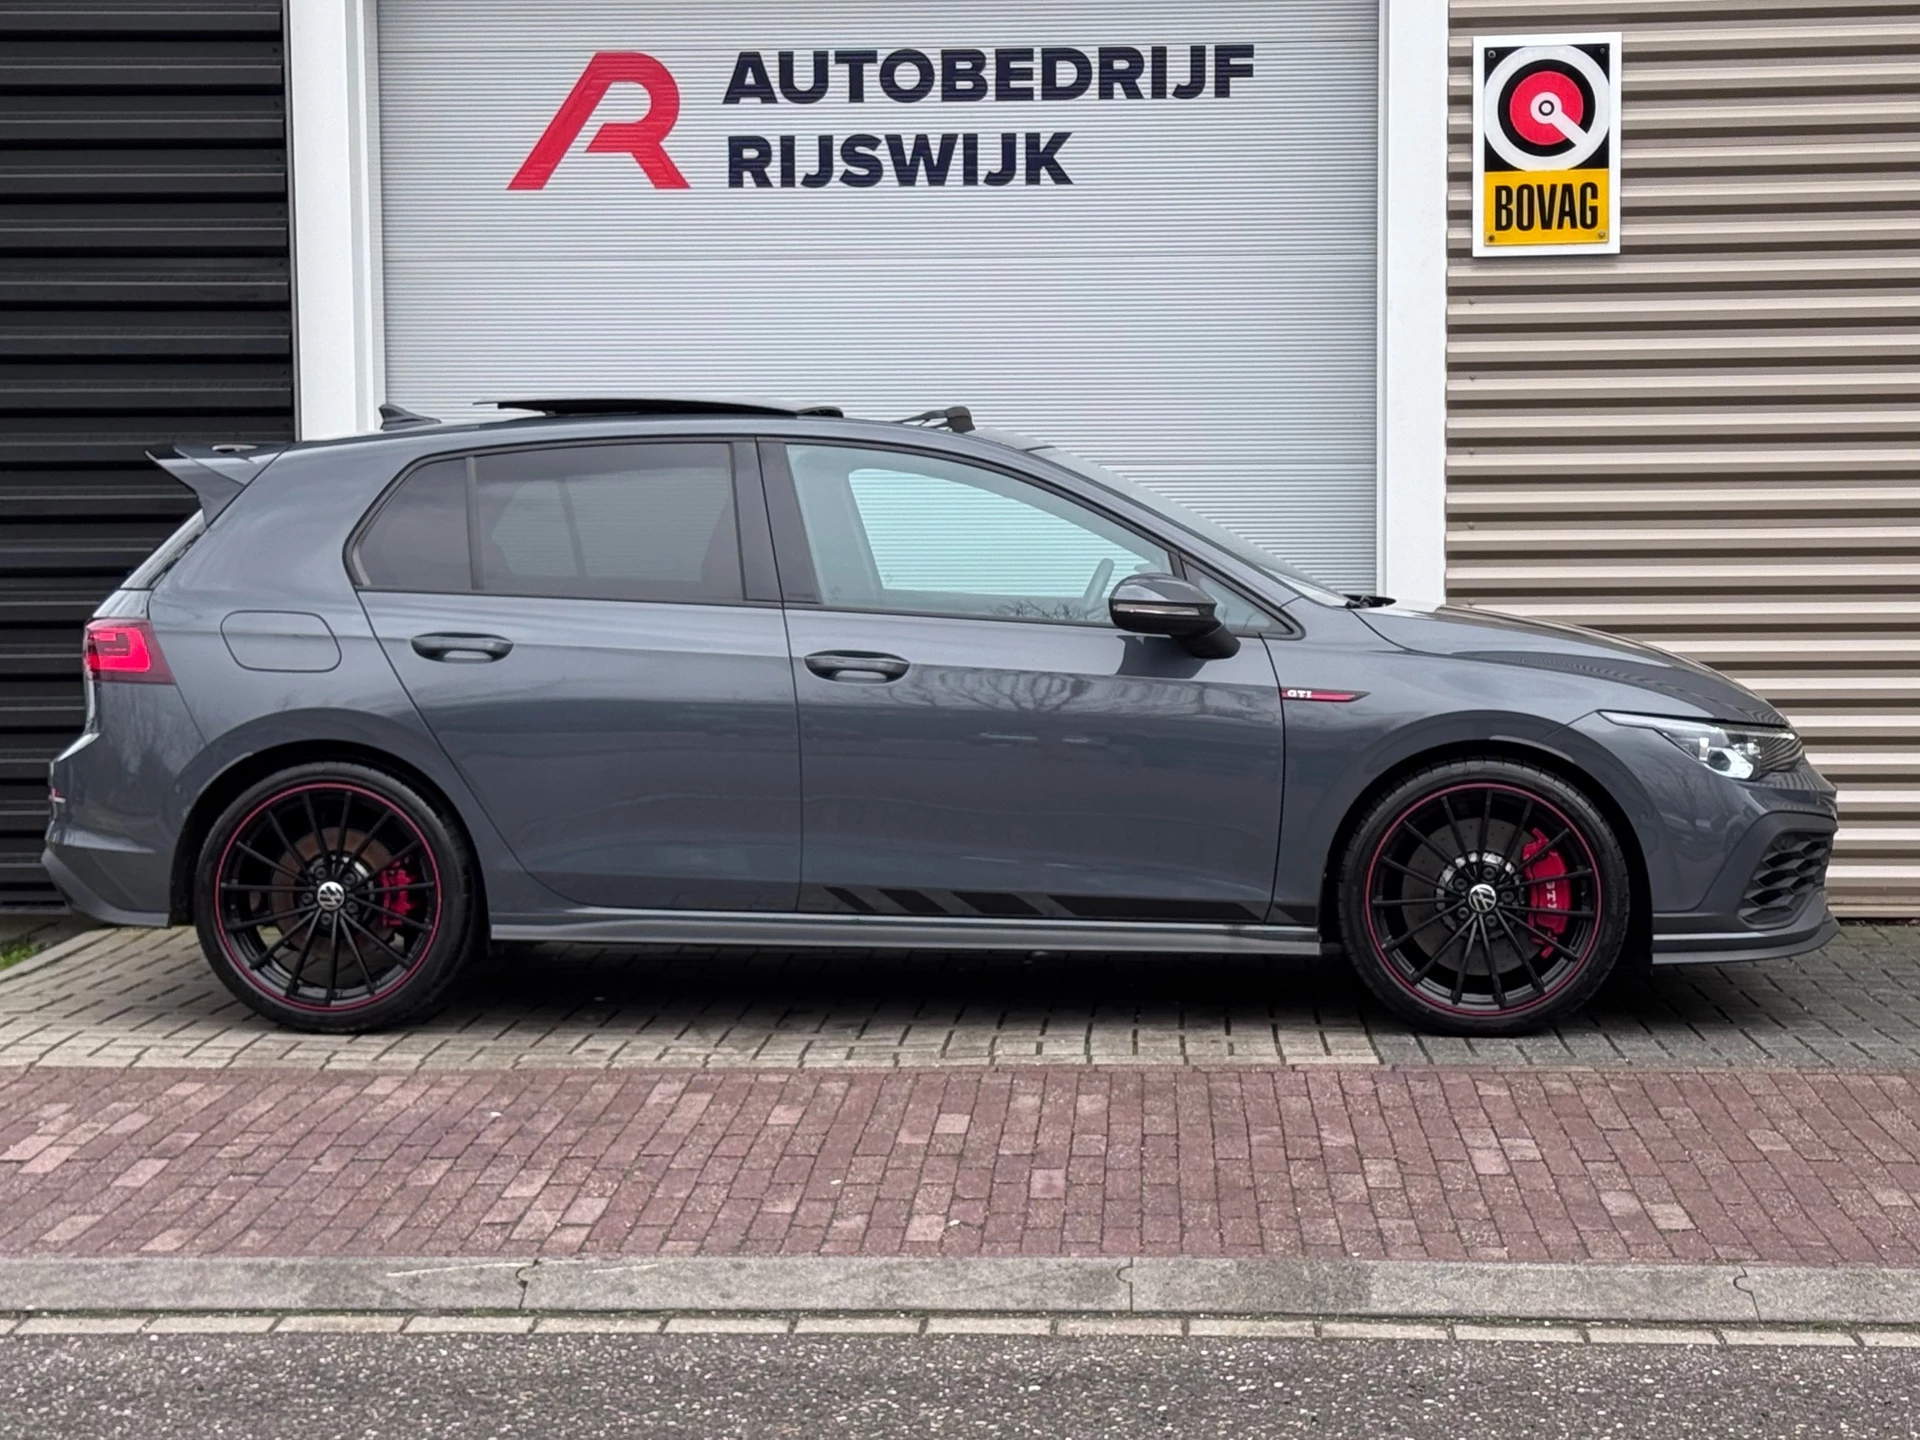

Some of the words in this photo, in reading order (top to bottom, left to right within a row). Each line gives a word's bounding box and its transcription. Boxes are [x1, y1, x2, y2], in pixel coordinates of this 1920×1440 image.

[723, 45, 1255, 105] AUTOBEDRIJF
[728, 132, 1072, 189] RIJSWIJK
[1494, 182, 1599, 232] BOVAG
[1286, 689, 1313, 699] GTI
